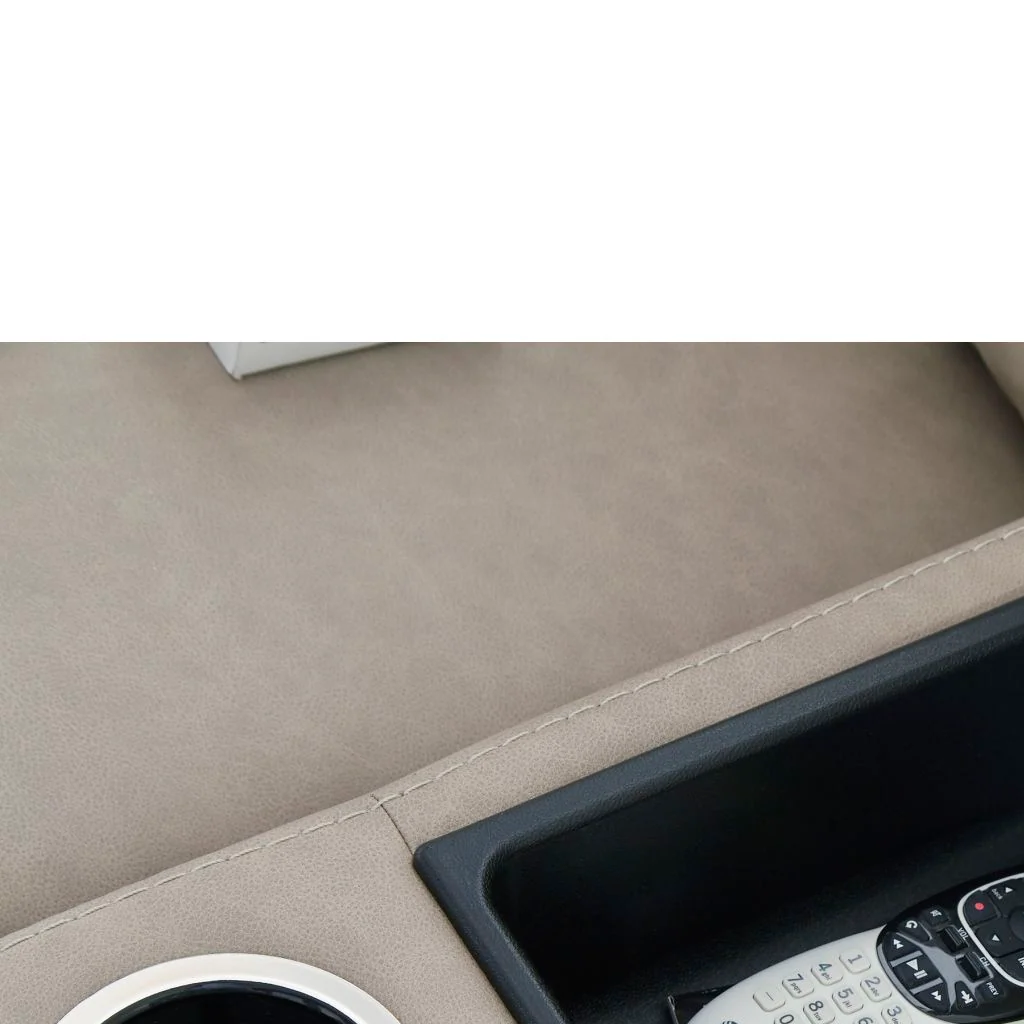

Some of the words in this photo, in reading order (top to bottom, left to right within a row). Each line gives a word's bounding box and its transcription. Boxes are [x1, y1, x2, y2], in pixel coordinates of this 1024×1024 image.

[957, 927, 968, 940] VOL
[979, 955, 989, 968] CH
[986, 981, 998, 995] PREV
